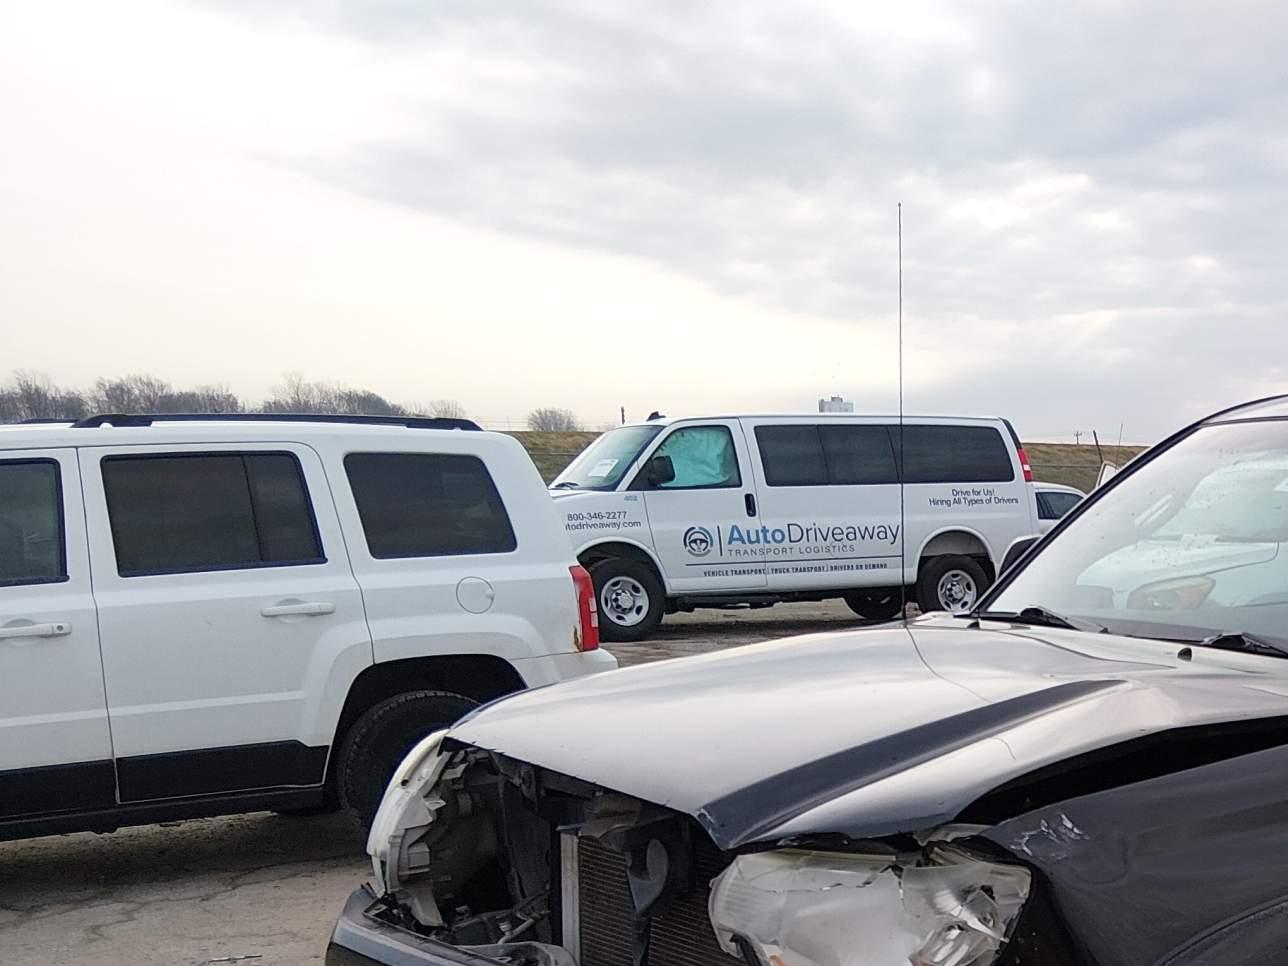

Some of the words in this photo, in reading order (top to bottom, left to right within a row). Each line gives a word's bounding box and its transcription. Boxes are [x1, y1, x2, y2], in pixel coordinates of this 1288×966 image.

[951, 488, 971, 496] Drive
[972, 488, 981, 496] for
[983, 488, 995, 496] Us!
[928, 498, 952, 507] Hiring
[952, 497, 961, 505] All
[963, 497, 984, 507] Types
[985, 496, 993, 504] of
[994, 496, 1019, 504] Drivers
[727, 547, 794, 557] TRANSPORT
[799, 544, 856, 554] LOGISTICS
[703, 569, 729, 577] VEHICLE
[731, 568, 766, 577] TRANSPORT
[771, 567, 790, 575] TRUCK
[791, 565, 825, 573] TRANSPORT
[830, 563, 854, 572] DRIVERS
